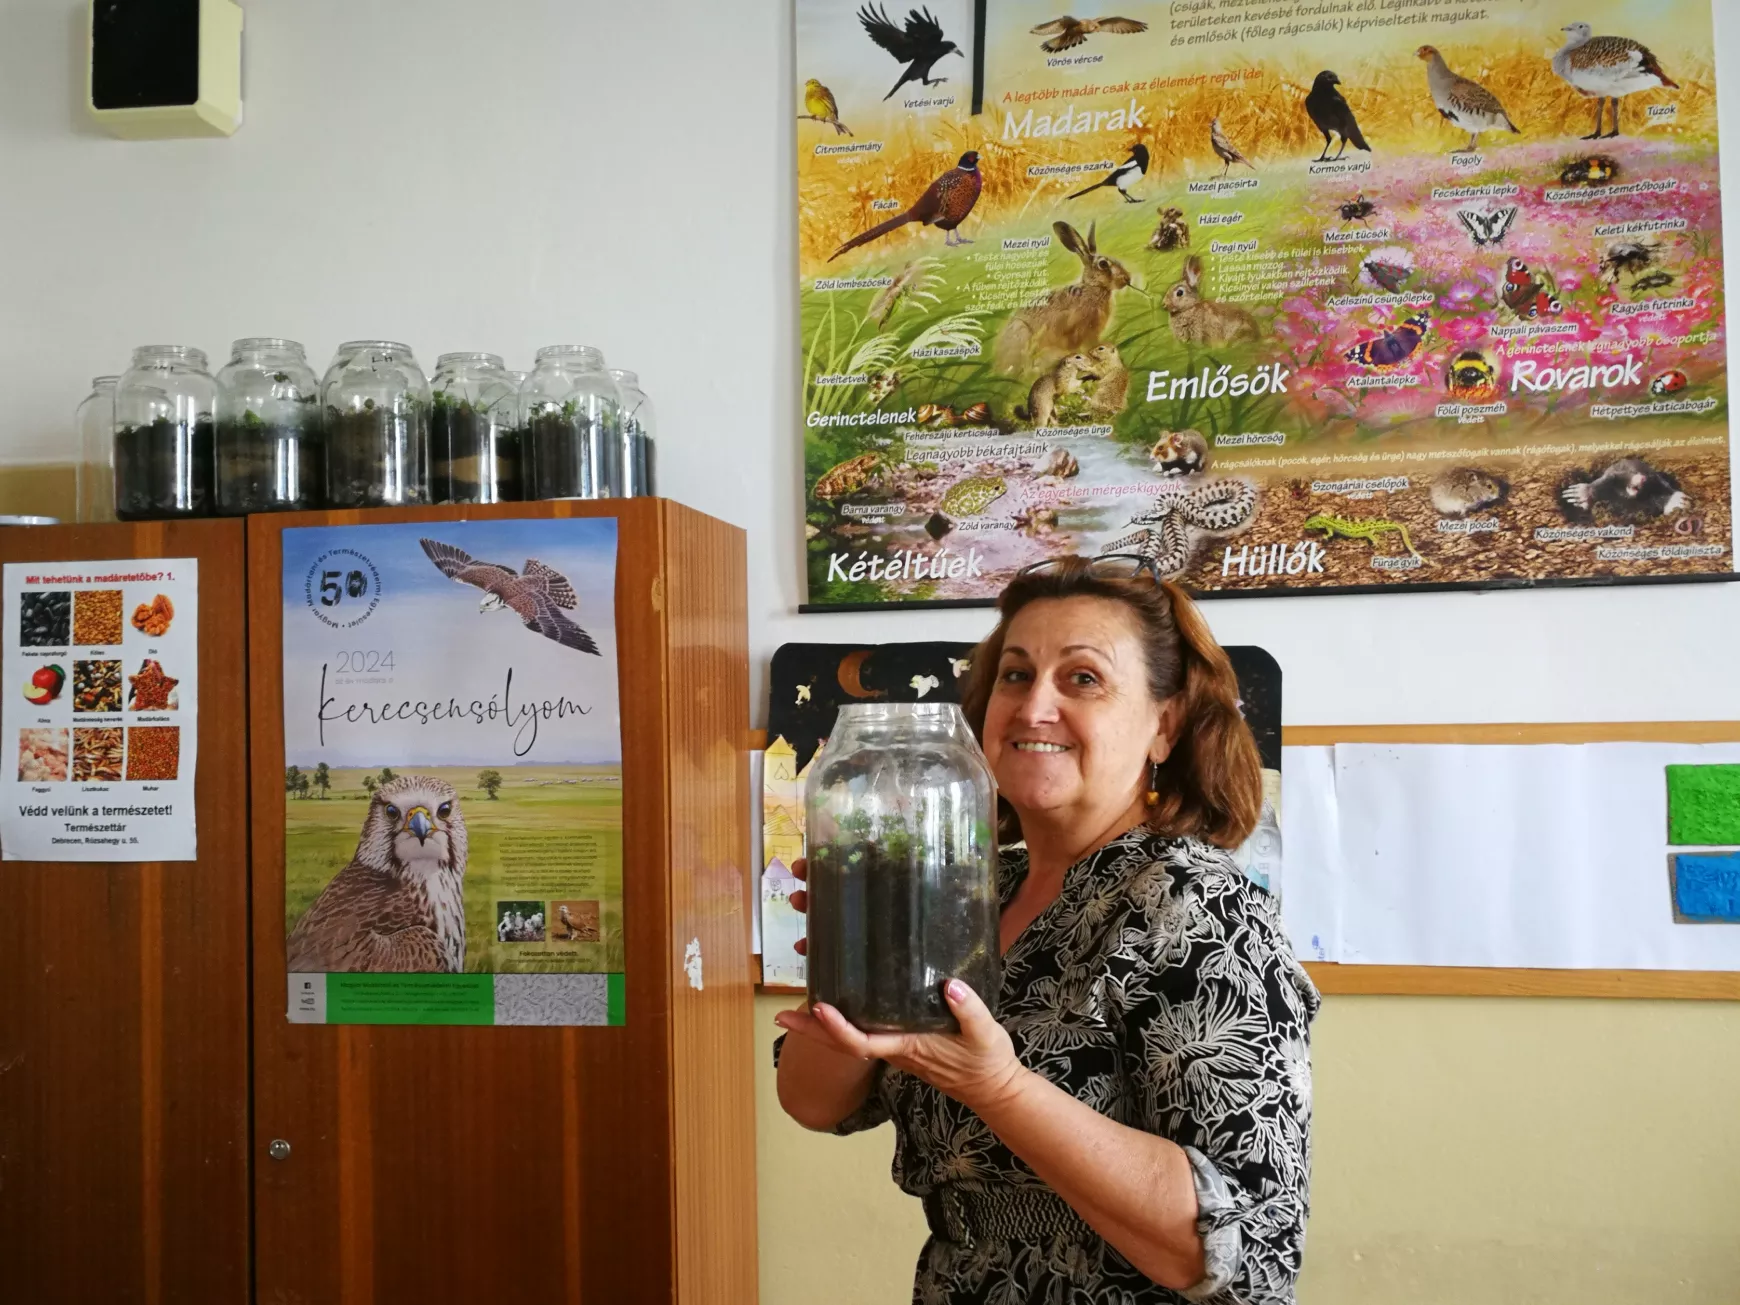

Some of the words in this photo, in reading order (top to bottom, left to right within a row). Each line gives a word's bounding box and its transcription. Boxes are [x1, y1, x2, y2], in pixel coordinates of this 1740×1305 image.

[1171, 13, 1241, 29] területeken
[1244, 5, 1294, 22] kevésbé
[1295, 0, 1353, 16] fordulnak
[1170, 35, 1185, 47] és
[1187, 28, 1238, 45] emlősök
[1240, 25, 1276, 42] (főleg
[1278, 17, 1344, 36] rágcsálók)
[1346, 12, 1428, 32] képviseltetik
[1431, 8, 1490, 25] magukat.
[1047, 57, 1072, 67] Vörös
[1074, 54, 1104, 65] vércse
[1003, 91, 1012, 103] A
[1015, 88, 1059, 104] legtöbb
[1062, 84, 1100, 99] madár
[1102, 81, 1130, 94] csak
[1134, 81, 1147, 91] az
[1149, 72, 1207, 89] élelemért
[1210, 68, 1241, 86] repül
[903, 98, 932, 109] Vetési
[932, 96, 955, 108] varjú
[1647, 104, 1676, 116] Túzok
[1003, 98, 1145, 141] Madarak
[814, 142, 882, 155] Citromsármány
[1451, 154, 1483, 167] Fogoly
[1028, 163, 1082, 176] Közönséges
[1083, 160, 1114, 171] szarka
[1309, 165, 1346, 175] Kormos
[1347, 161, 1371, 174] varjú
[1189, 180, 1217, 193] Mezei
[1217, 178, 1258, 191] pacsirta
[1432, 185, 1492, 199] Fecskefarkú
[1492, 184, 1518, 197] lepke
[1545, 188, 1606, 201] Közönséges
[1608, 180, 1677, 195] temetőbogár
[873, 200, 898, 210] Fácán
[1199, 213, 1220, 225] Házi
[1220, 212, 1243, 225] egér
[1326, 231, 1354, 241] Mezei
[1355, 228, 1388, 240] tücsök
[1594, 224, 1625, 236] Keleti
[1626, 219, 1685, 232] kékfutrinka
[1003, 239, 1030, 249] Mezei
[1031, 237, 1050, 249] nyúl
[1211, 240, 1236, 254] Üregi
[1237, 240, 1257, 252] nyúl
[815, 279, 834, 290] Zöld
[836, 277, 892, 288] lombszöcske
[1327, 294, 1374, 306] Acélszínű
[1374, 291, 1433, 305] csüngőlepke
[1611, 302, 1650, 314] Ragyás
[1652, 298, 1694, 309] futrinka
[1490, 326, 1527, 339] Nappali
[1528, 323, 1577, 336] pávaszem
[913, 348, 933, 358] Házi
[933, 345, 981, 358] kaszáspók
[1496, 344, 1505, 355] A
[816, 373, 867, 384] Levéltetvek
[1511, 354, 1643, 392] Rovarok
[1146, 362, 1290, 402] Emlősök
[1347, 375, 1416, 387] Atalantalepke
[1437, 403, 1461, 415] Földi
[1462, 402, 1505, 415] poszméh
[1592, 405, 1650, 418] Hétpettyes
[1652, 399, 1716, 413] katicabogár
[807, 406, 917, 427] Gerinctelenek
[905, 430, 952, 442] Fehérszájú
[1035, 427, 1090, 438] Közönséges
[1091, 425, 1112, 436] ürge
[1216, 435, 1245, 446] Mezei
[1246, 432, 1284, 445] hörcsög
[906, 445, 974, 463] Legnagyobb
[976, 442, 1049, 459] békafajtáink
[1020, 488, 1036, 500] Az
[1038, 485, 1090, 501] egyetlen
[1091, 480, 1182, 498] mérgeskígyónk
[1312, 480, 1364, 493] Szongáriai
[1365, 477, 1408, 491] cselőpók
[841, 504, 869, 515] Barna
[869, 504, 905, 515] varangy
[958, 521, 979, 532] Zöld
[980, 521, 1015, 532] varangy
[1439, 521, 1468, 532] Mezei
[1468, 519, 1499, 532] pocok
[1535, 528, 1596, 539] Közönséges
[1597, 526, 1632, 536] vakond
[1221, 541, 1326, 577] Hüllők
[1598, 548, 1660, 559] Közönséges
[827, 547, 985, 582] Kétéltűek
[1372, 557, 1400, 569] Fürge
[26, 575, 40, 584] Mit
[42, 573, 84, 585] tehetünk
[94, 571, 164, 583] madáretetőbe?
[167, 572, 176, 581] 1.
[336, 650, 396, 673] 2024
[318, 663, 592, 757] kerecsensólyom
[19, 805, 48, 817] Védd
[51, 804, 89, 816] velünk
[92, 807, 99, 816] a
[102, 804, 173, 816] természetet!
[64, 822, 127, 832] Természettár
[52, 837, 84, 846] Debrecen,
